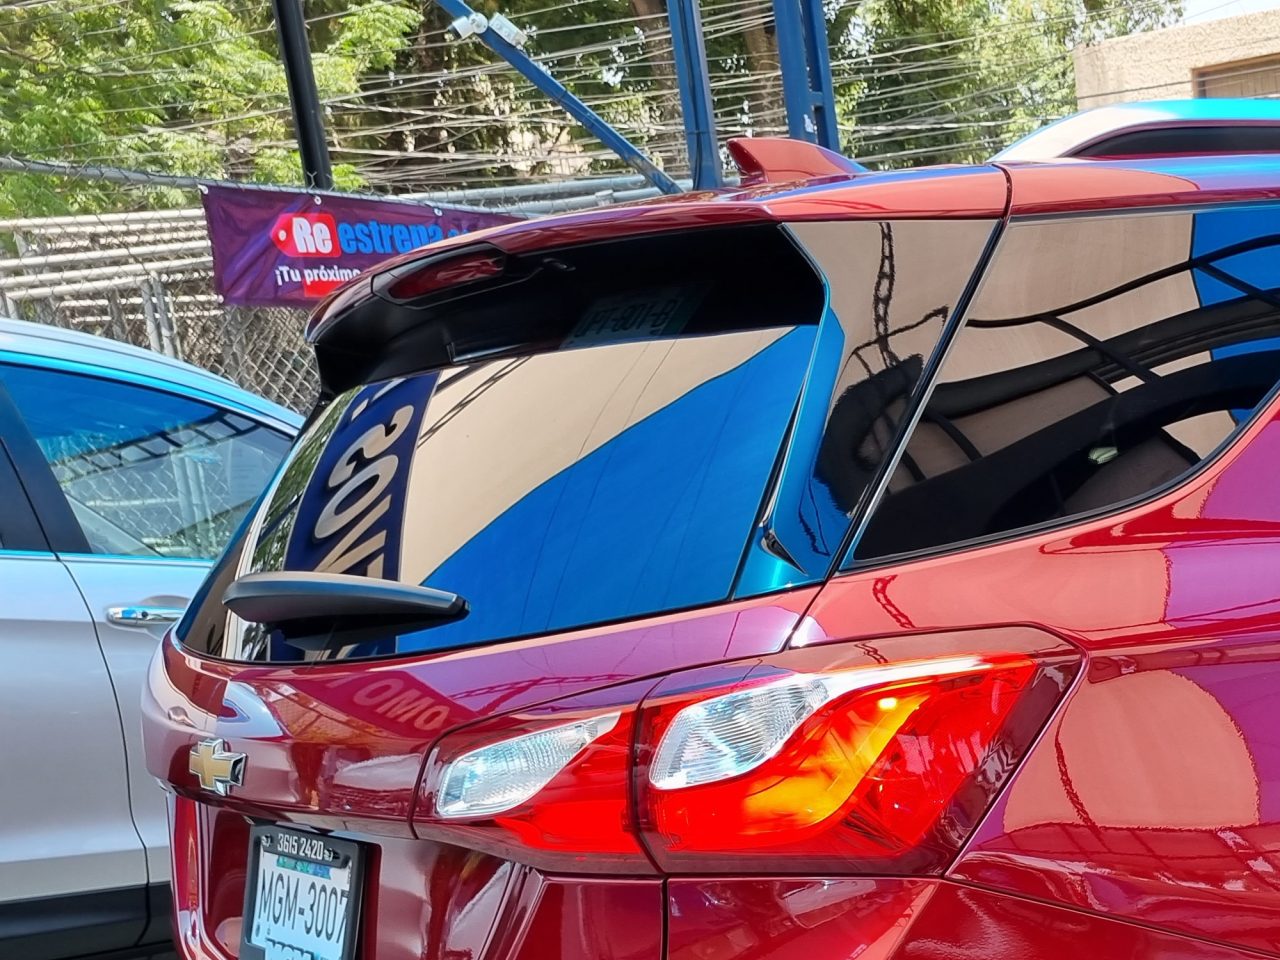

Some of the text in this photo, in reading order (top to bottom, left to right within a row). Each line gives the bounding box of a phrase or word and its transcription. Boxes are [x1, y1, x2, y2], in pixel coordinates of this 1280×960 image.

[277, 833, 324, 861] 3615 2420
[258, 869, 349, 944] MGM-3007
